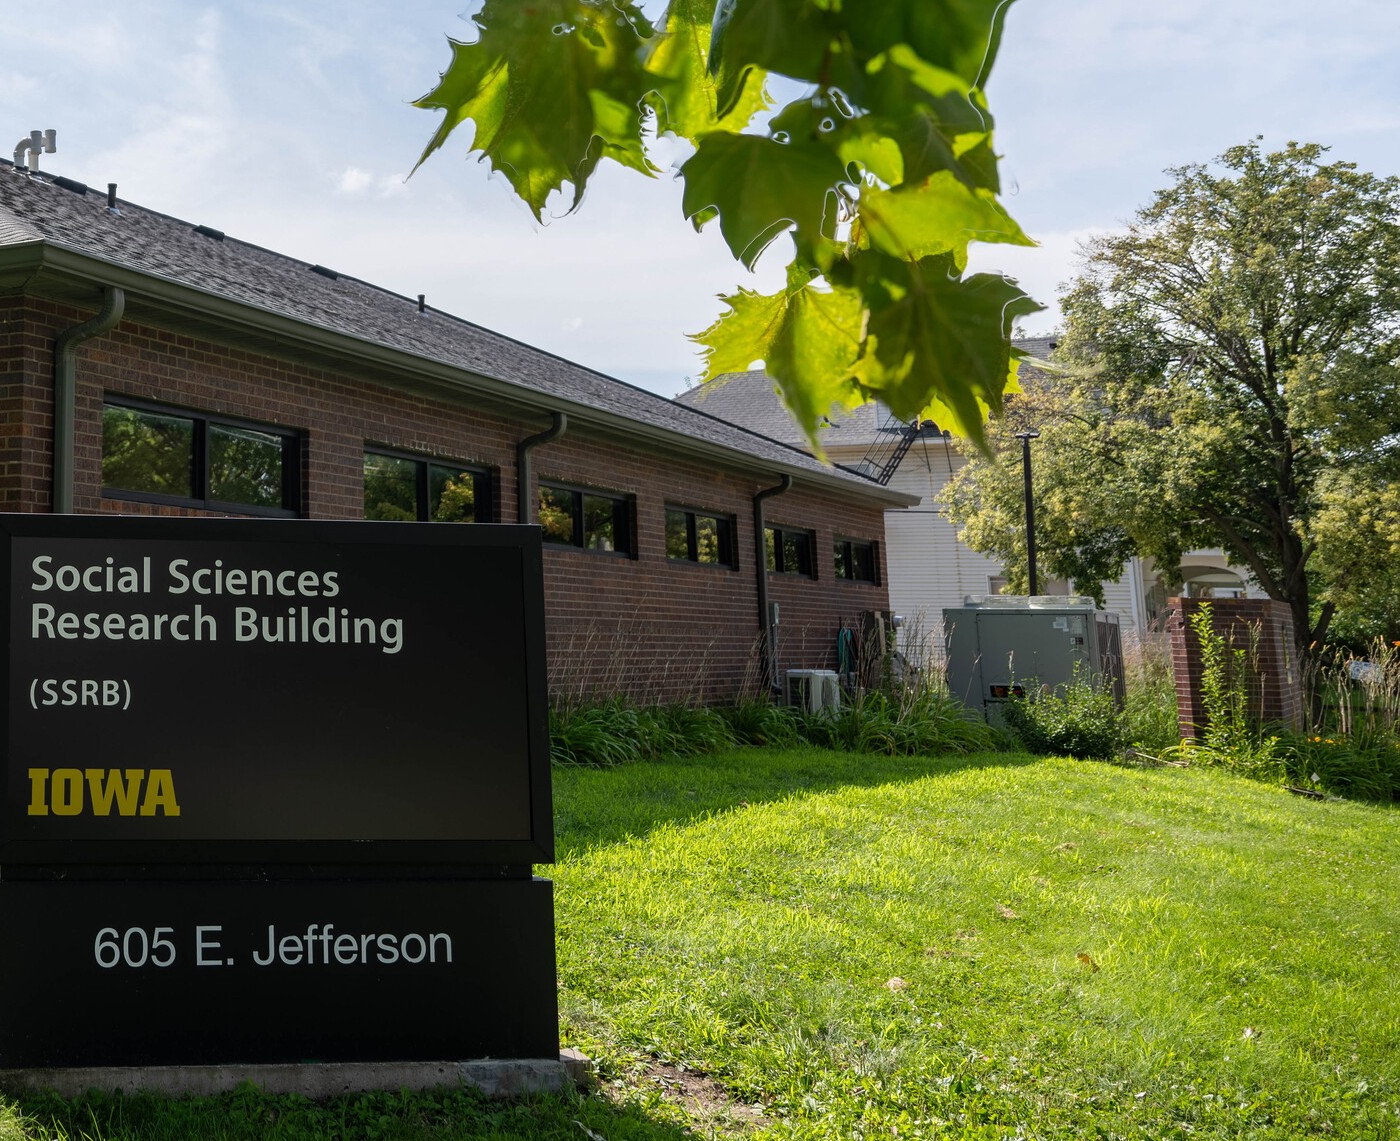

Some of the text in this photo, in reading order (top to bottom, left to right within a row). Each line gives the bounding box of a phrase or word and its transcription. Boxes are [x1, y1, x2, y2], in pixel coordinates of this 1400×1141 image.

[31, 556, 340, 597] Social Sciences
[31, 603, 404, 654] Research Building
[30, 679, 132, 710] (SSRB)
[28, 768, 180, 816] IOWA
[94, 924, 452, 967] 605 E. Jefferson
